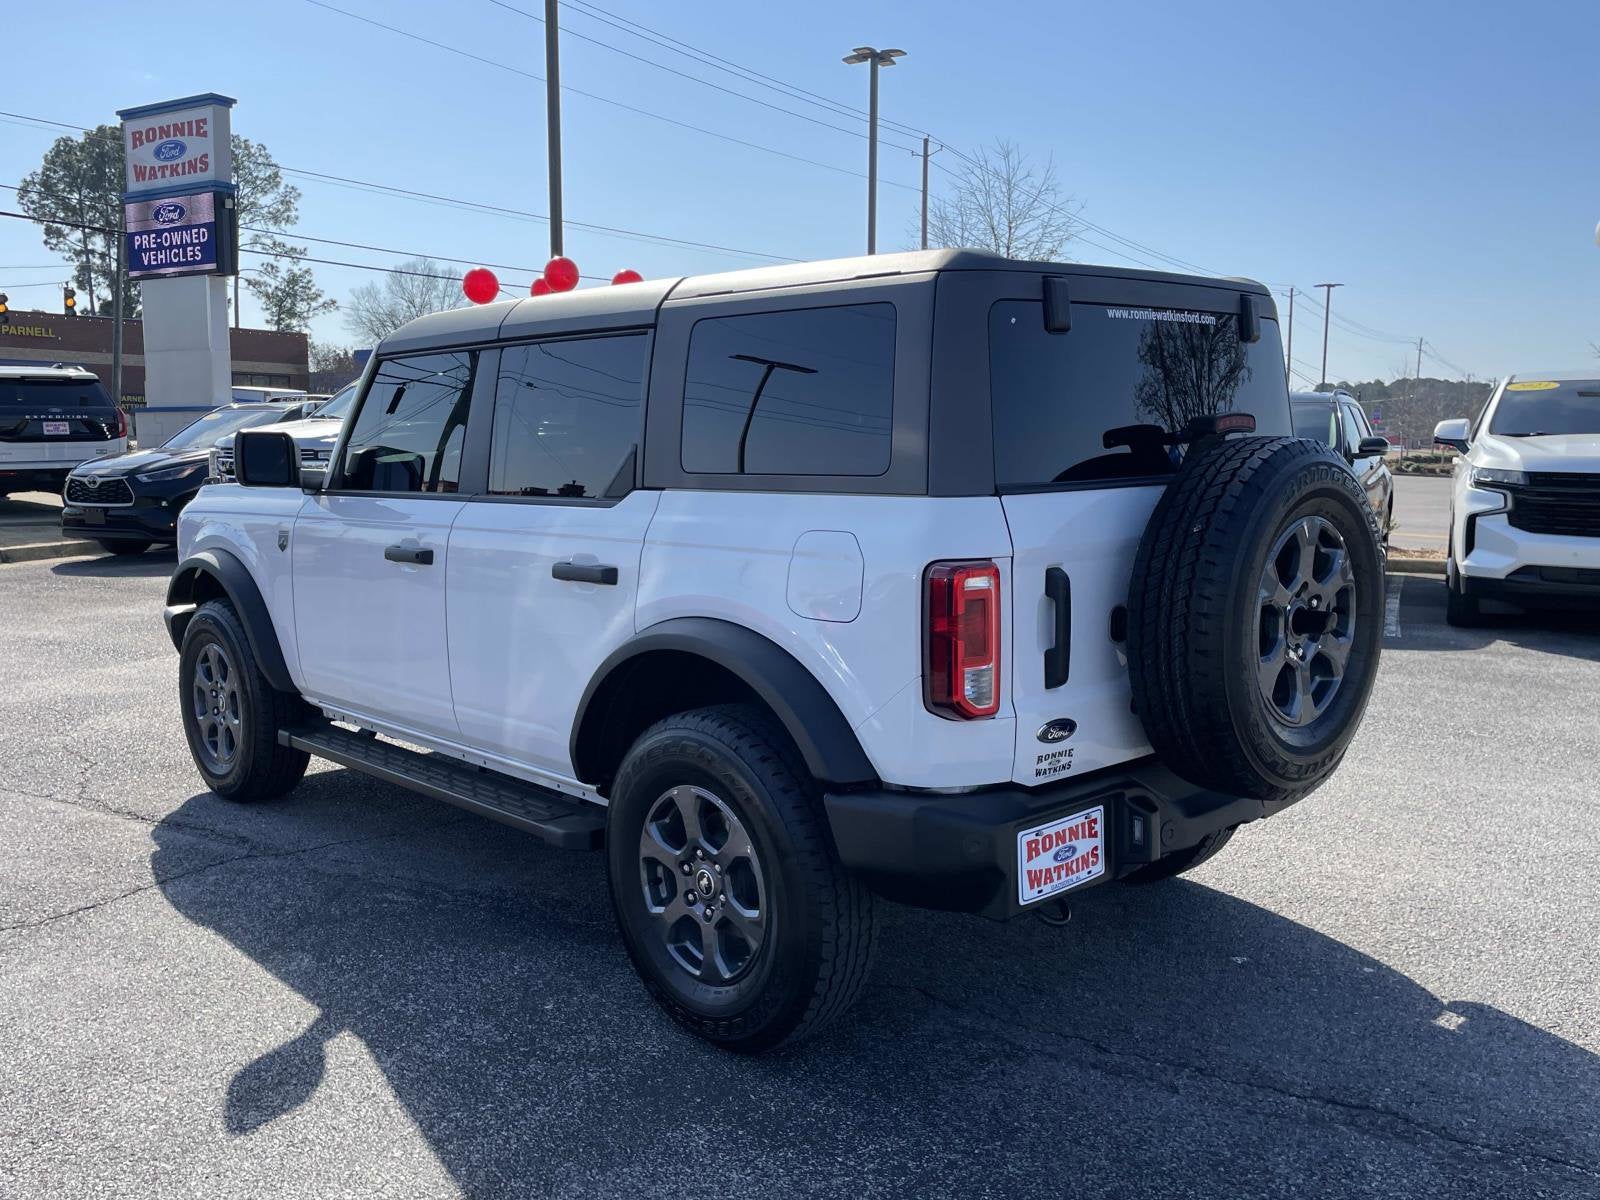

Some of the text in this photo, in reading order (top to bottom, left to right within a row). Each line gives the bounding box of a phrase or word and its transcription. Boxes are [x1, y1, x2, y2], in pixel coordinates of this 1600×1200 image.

[132, 118, 208, 150] RONNIE
[133, 153, 209, 182] WATKINS
[134, 228, 208, 250] PRE-OWNED
[141, 246, 202, 266] VEHICLES
[1107, 309, 1216, 325] www.ronniewatkinsford.com
[1, 325, 56, 338] PARNELL
[1036, 748, 1074, 766] RONNIE
[1035, 760, 1073, 777] WATKINS
[1026, 817, 1099, 863] RONNIE
[1026, 845, 1100, 891] WATKINS
